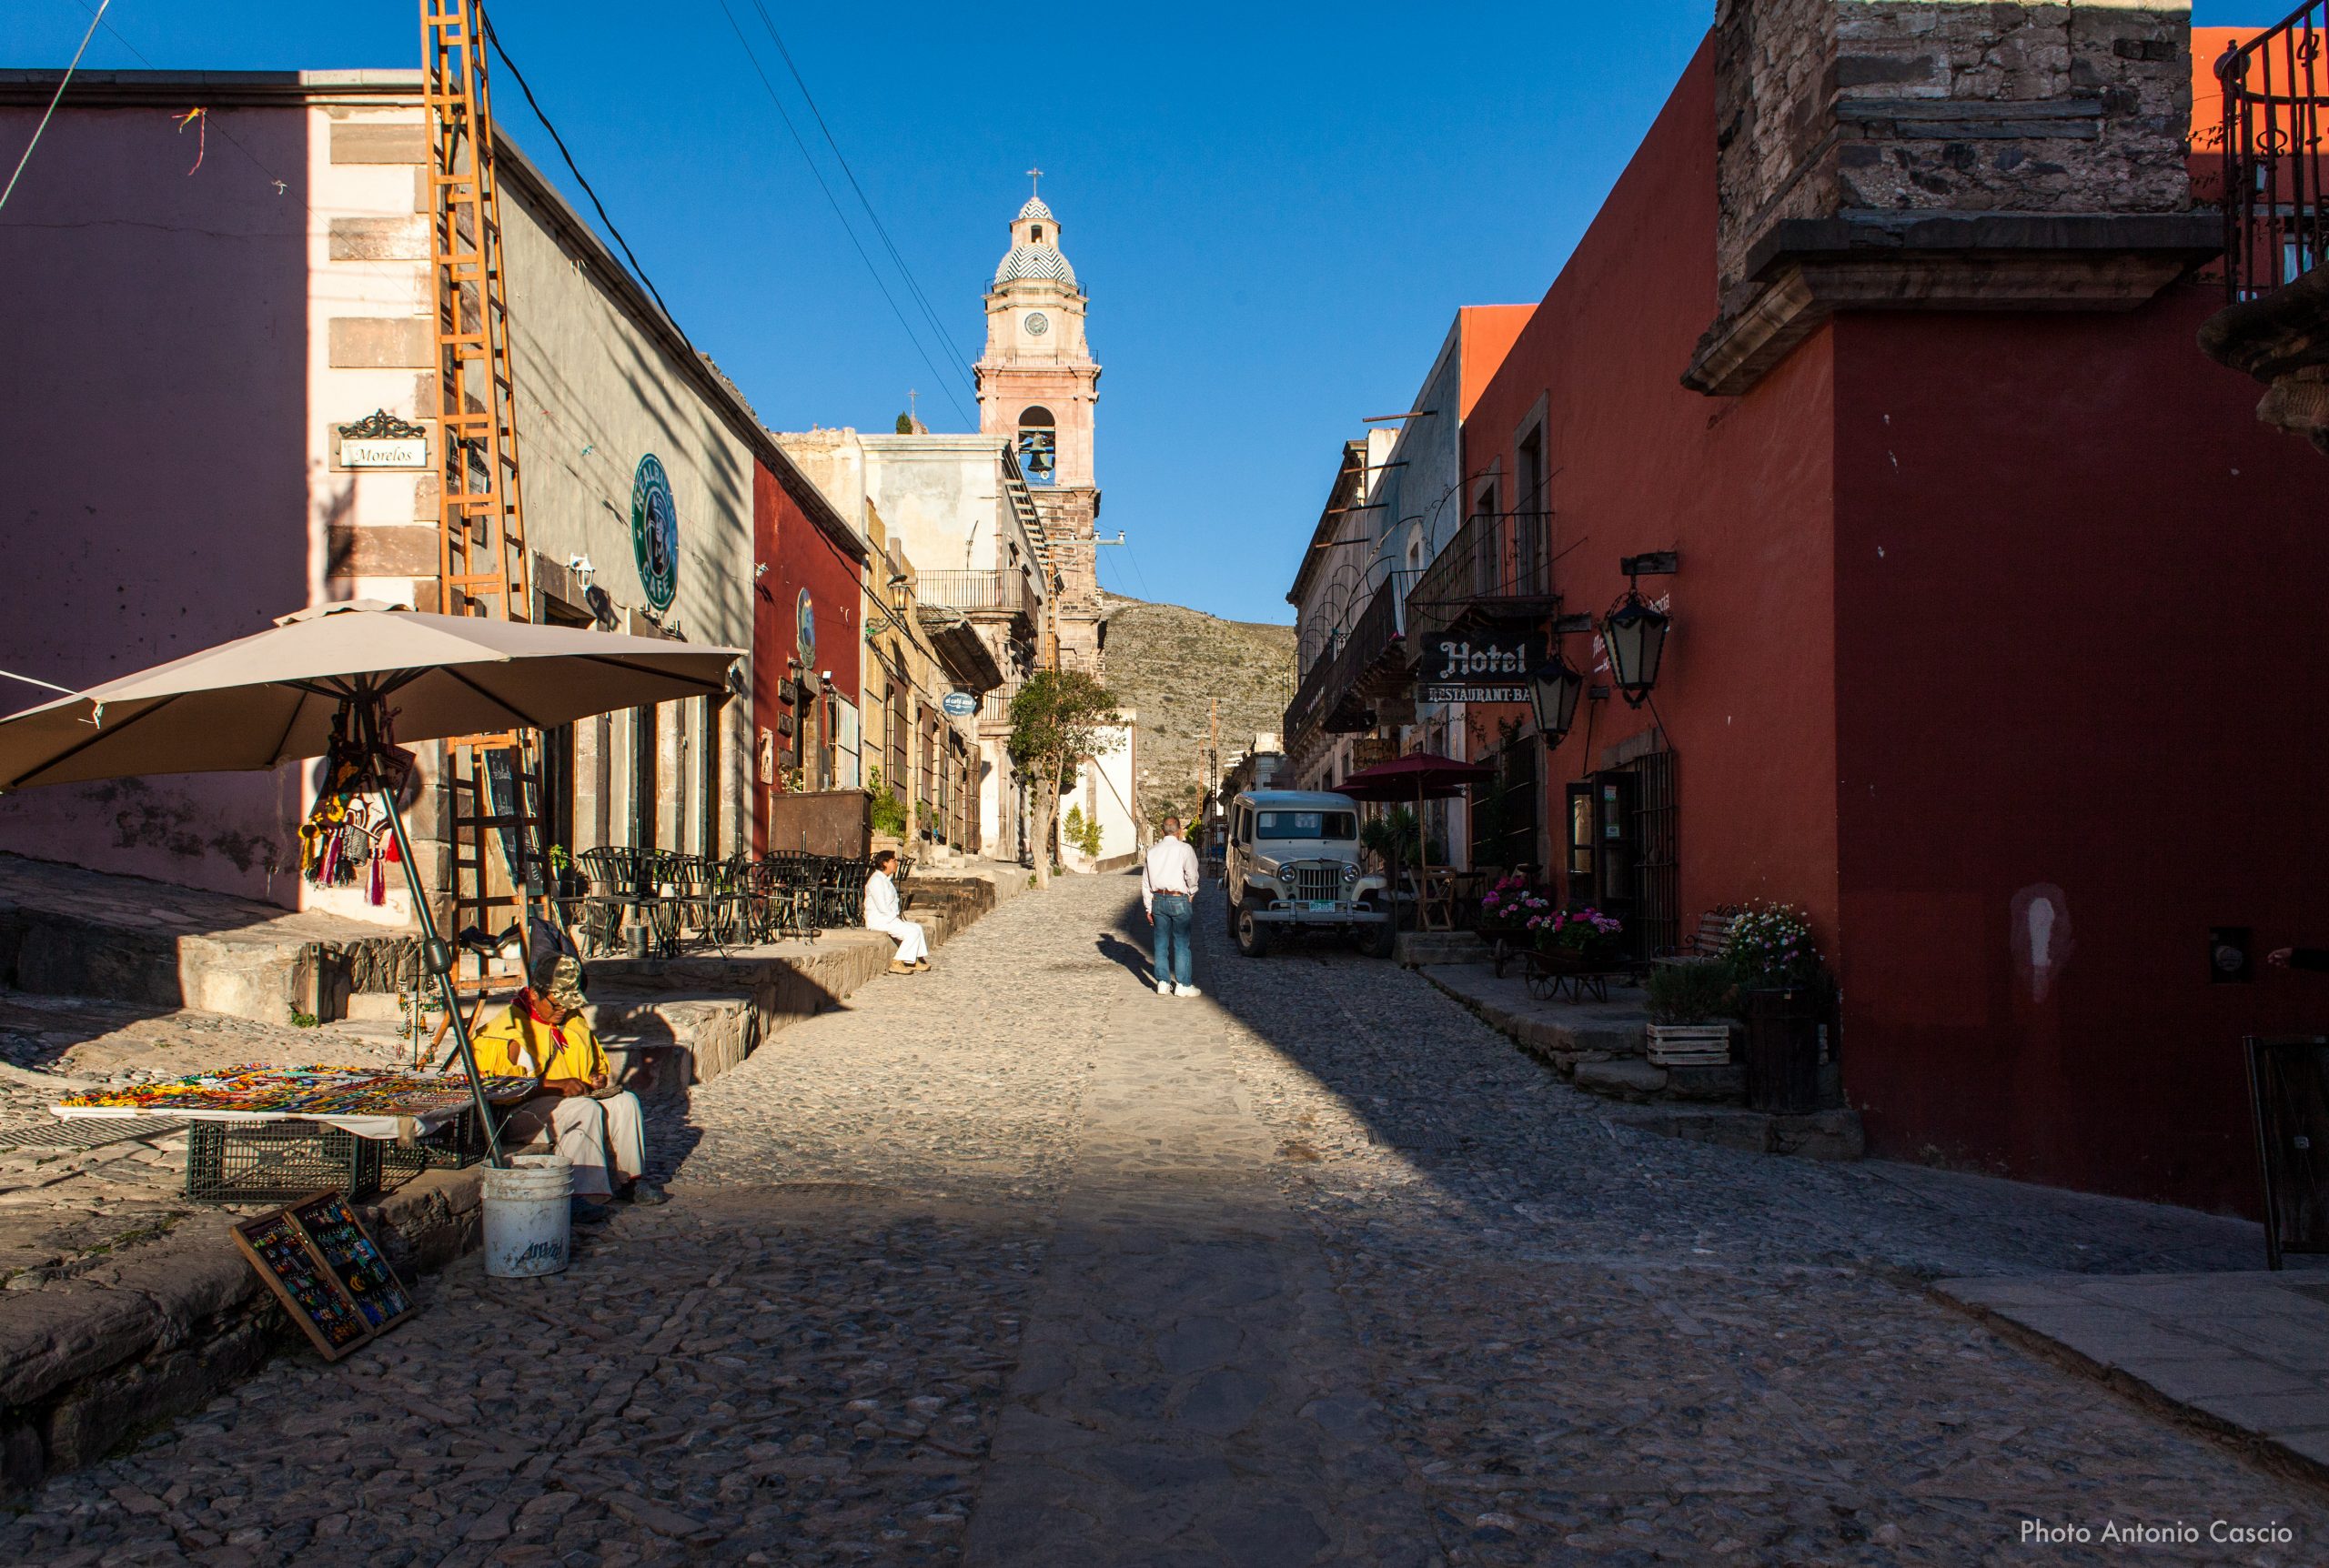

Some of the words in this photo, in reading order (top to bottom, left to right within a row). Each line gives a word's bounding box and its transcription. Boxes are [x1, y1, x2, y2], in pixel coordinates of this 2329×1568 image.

[355, 446, 413, 462] Morelos
[642, 561, 670, 599] CAFE
[1439, 640, 1527, 679] Hotel
